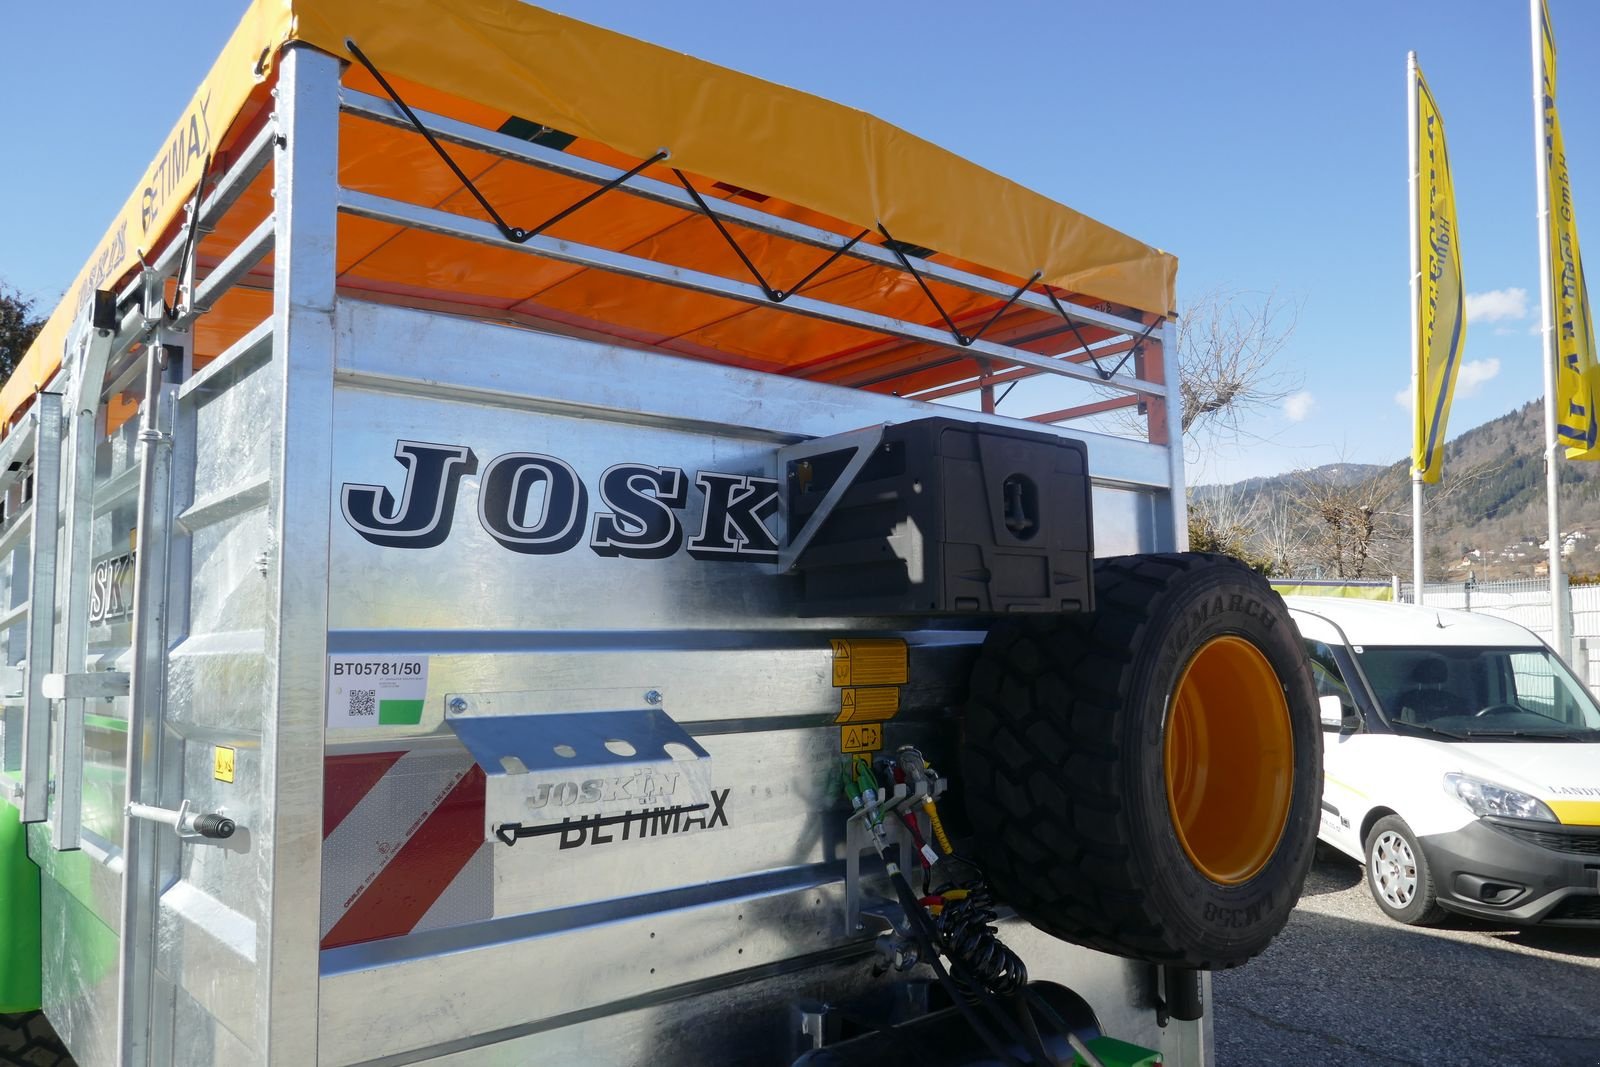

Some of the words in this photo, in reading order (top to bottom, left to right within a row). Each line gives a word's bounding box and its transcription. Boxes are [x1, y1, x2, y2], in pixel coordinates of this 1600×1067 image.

[340, 439, 778, 562] JOSK
[333, 662, 422, 676] BT05781/50
[526, 768, 680, 808] JOSKIN
